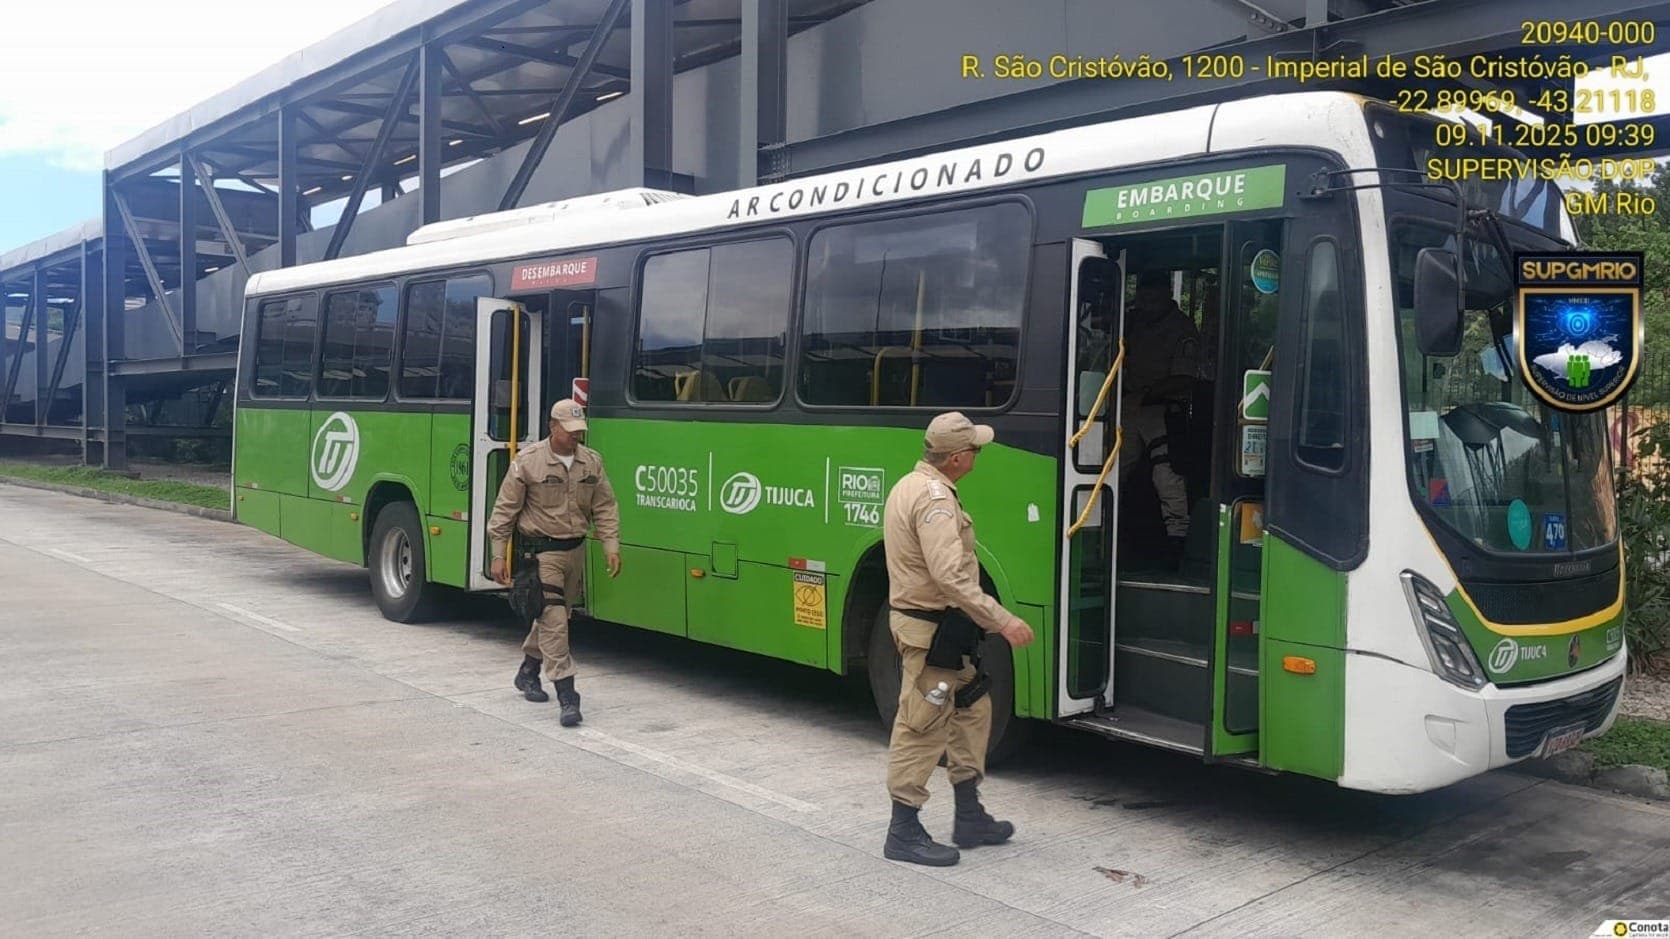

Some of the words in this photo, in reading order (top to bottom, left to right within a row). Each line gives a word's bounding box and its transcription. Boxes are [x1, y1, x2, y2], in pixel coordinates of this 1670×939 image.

[1117, 174, 1246, 209] EMBARQUE
[1116, 199, 1244, 220] BOARDING
[522, 262, 588, 281] DESEMBARQUE
[635, 465, 699, 497] C50035
[842, 474, 868, 491] RIO
[636, 494, 697, 512] TRANSCARIOCA
[765, 486, 815, 507] TIJUCA
[844, 503, 880, 525] 1746
